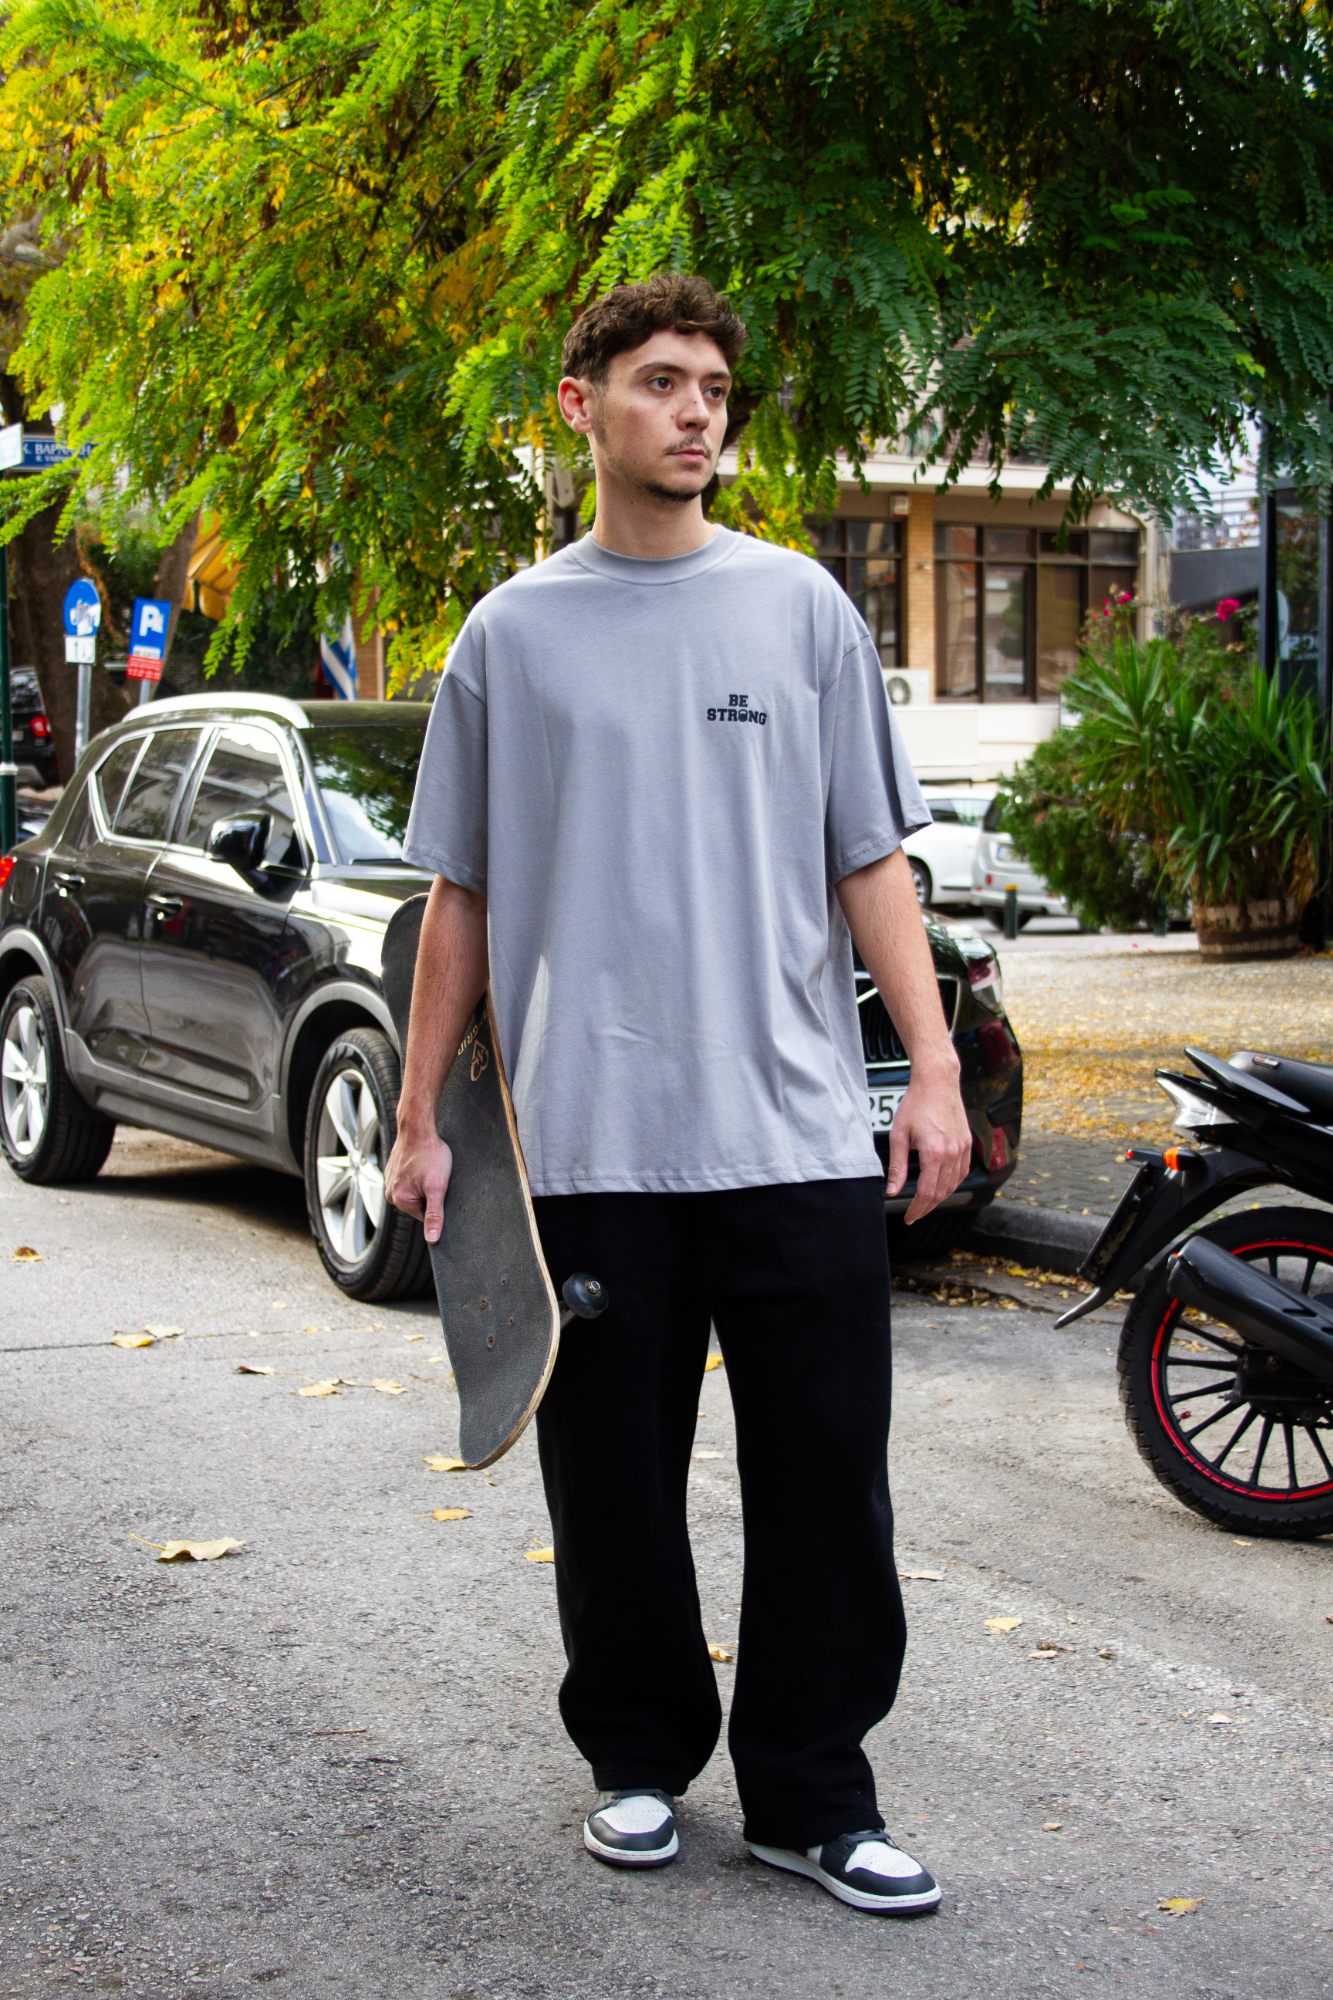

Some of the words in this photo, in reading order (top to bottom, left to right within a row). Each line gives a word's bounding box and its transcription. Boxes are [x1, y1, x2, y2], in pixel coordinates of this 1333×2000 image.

[139, 604, 161, 637] P
[728, 693, 749, 708] BE
[706, 708, 767, 726] STRONG
